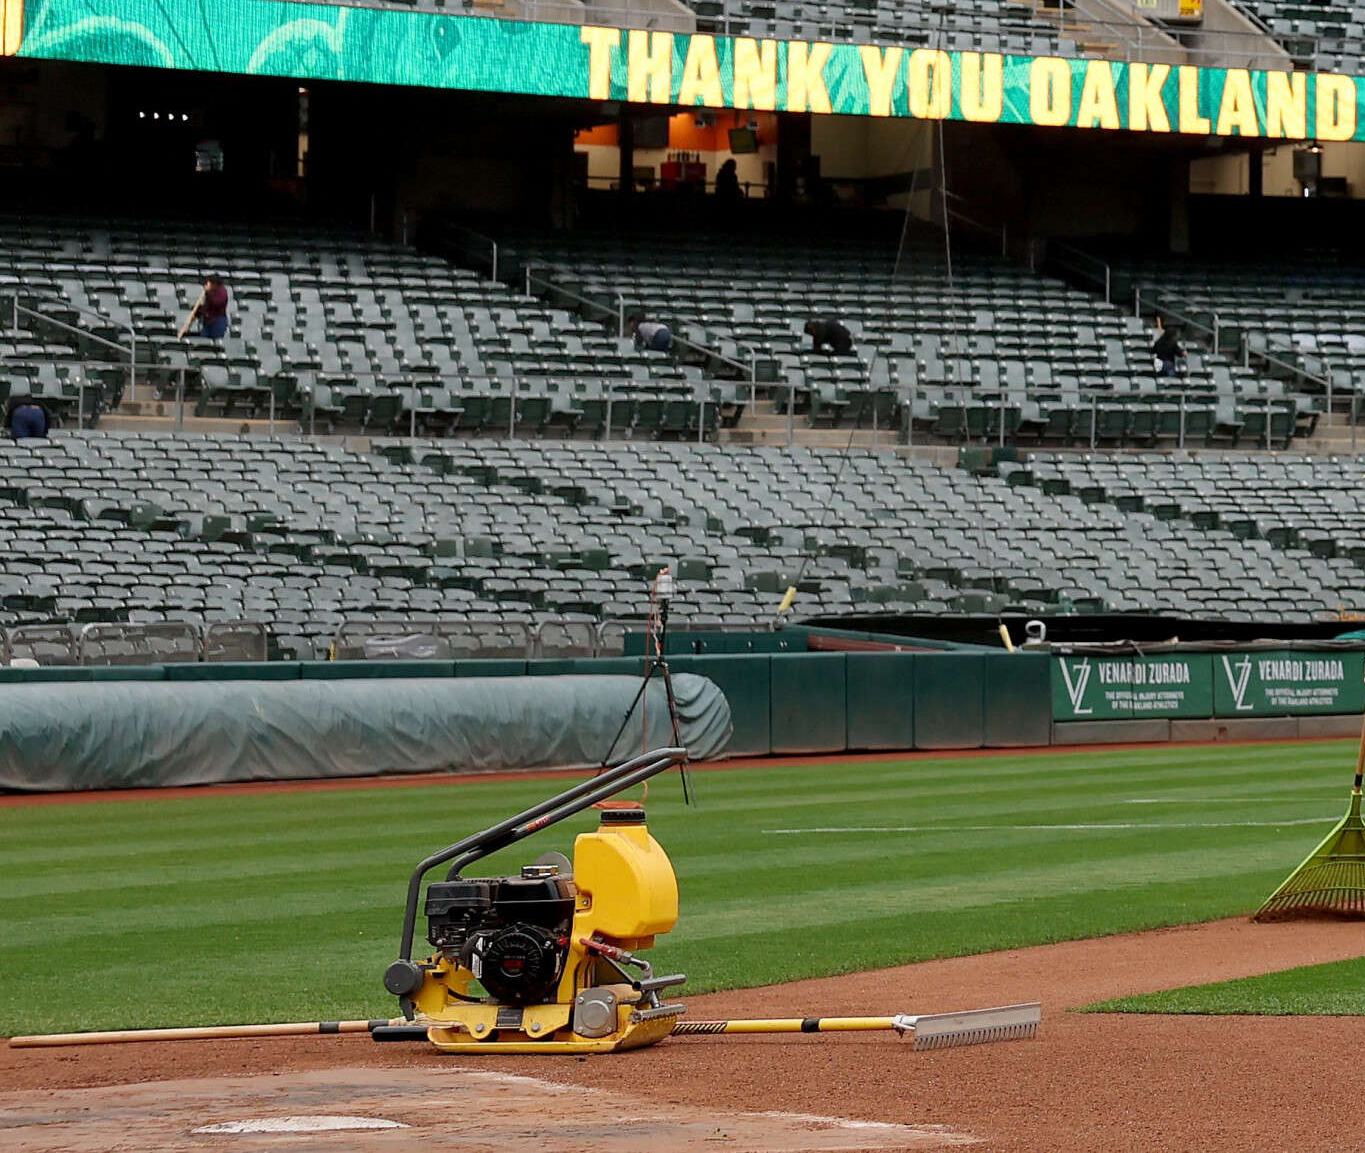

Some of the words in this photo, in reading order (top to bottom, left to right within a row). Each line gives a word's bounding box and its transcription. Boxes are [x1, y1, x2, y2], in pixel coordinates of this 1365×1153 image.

[581, 26, 833, 114] THANK
[859, 45, 1003, 122] YOU
[1029, 56, 1358, 142] OAKLAND
[1098, 662, 1146, 684] VENARDI
[1148, 662, 1190, 684] ZURADA
[1258, 659, 1302, 681] VENARDI
[1305, 660, 1344, 681] ZURADA
